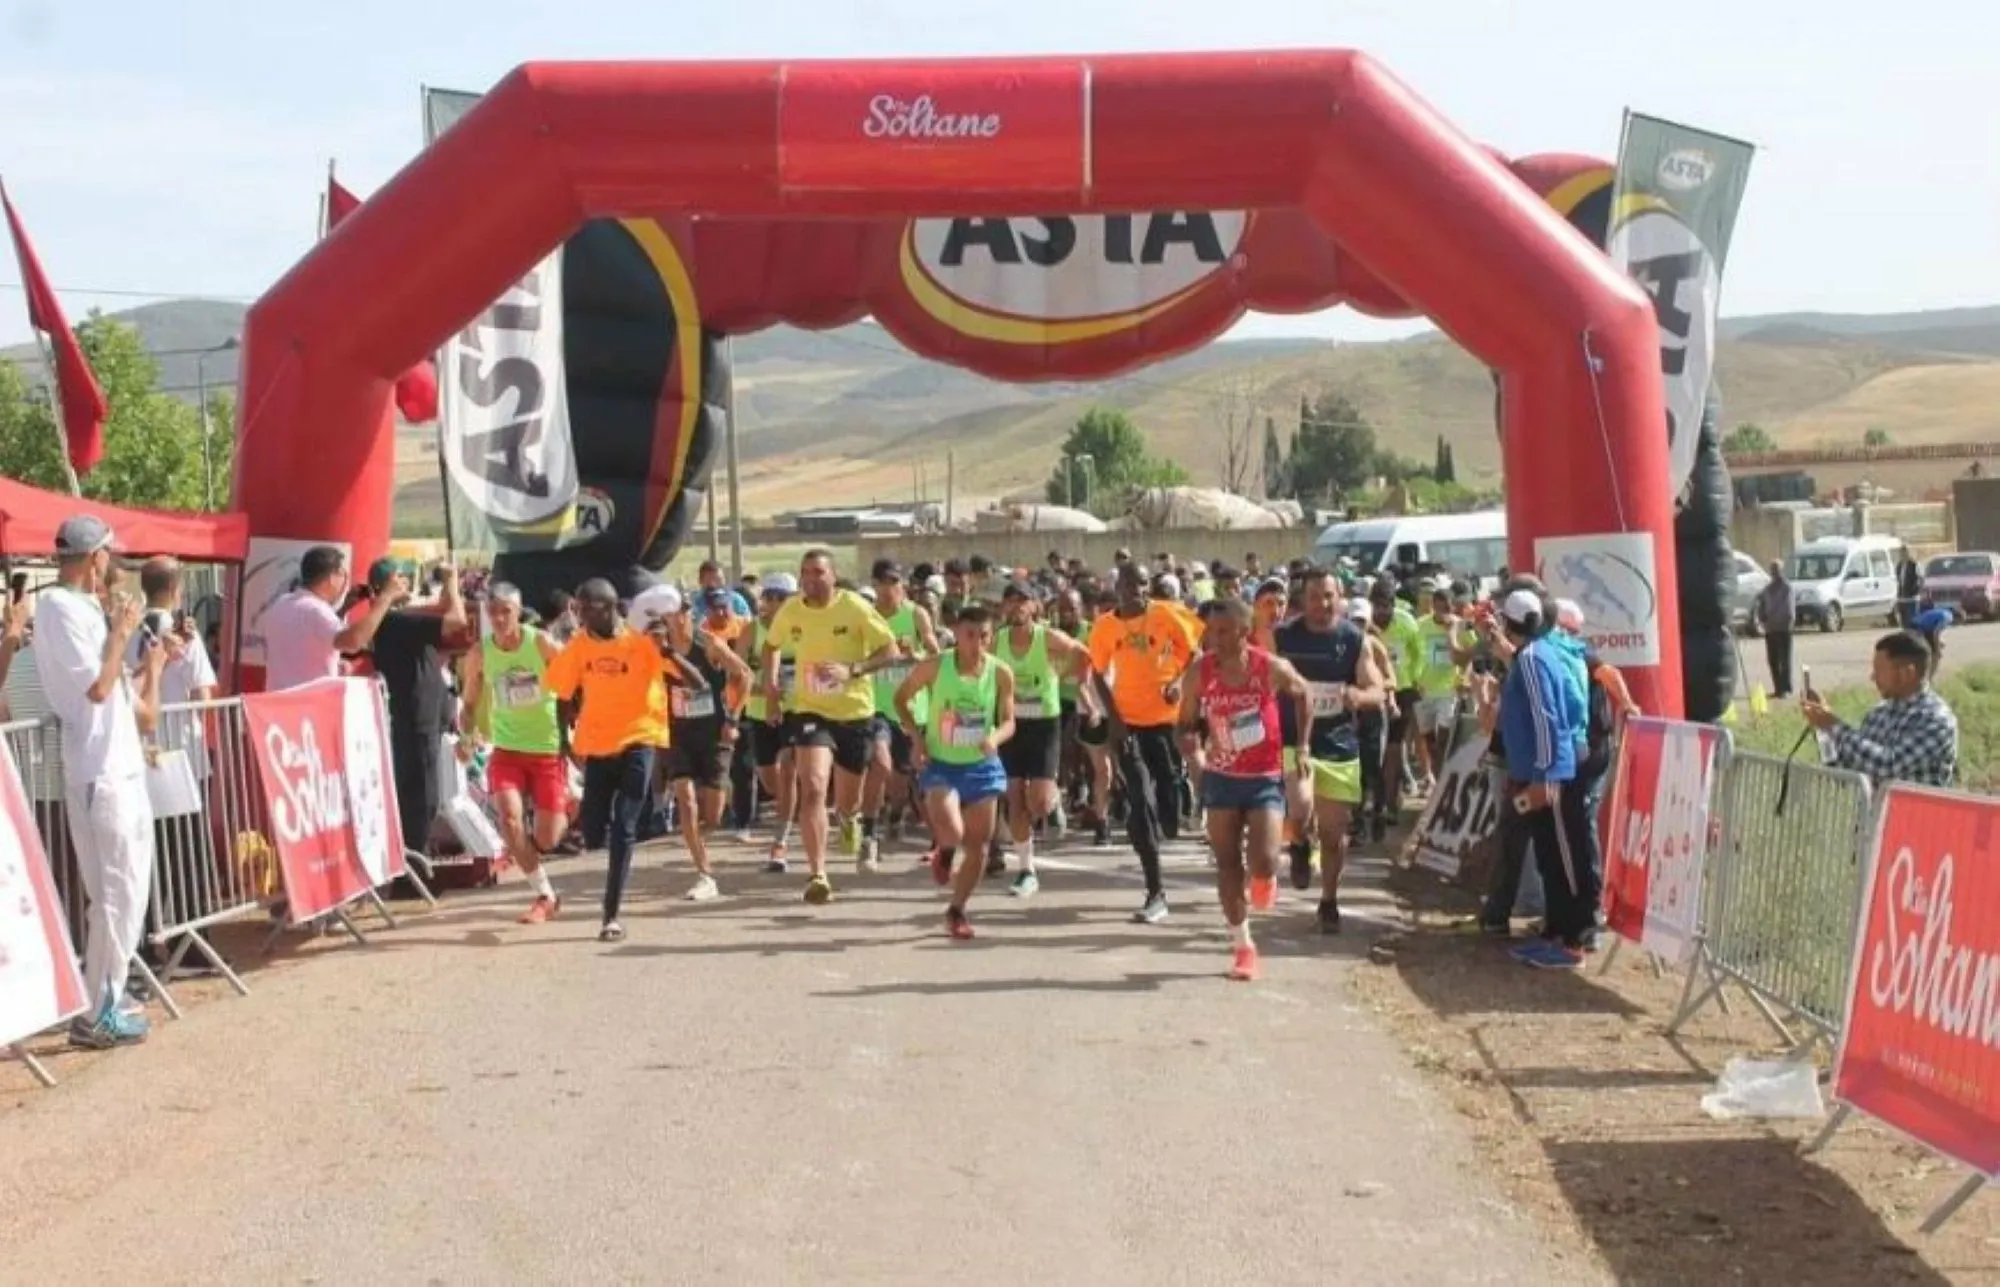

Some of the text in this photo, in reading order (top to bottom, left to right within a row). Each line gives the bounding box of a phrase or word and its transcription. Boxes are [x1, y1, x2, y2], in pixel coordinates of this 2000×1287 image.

[863, 94, 1001, 138] Soltane
[1663, 155, 1705, 184] ASTA
[458, 262, 548, 498] AST
[1871, 846, 2000, 1049] Soltan
